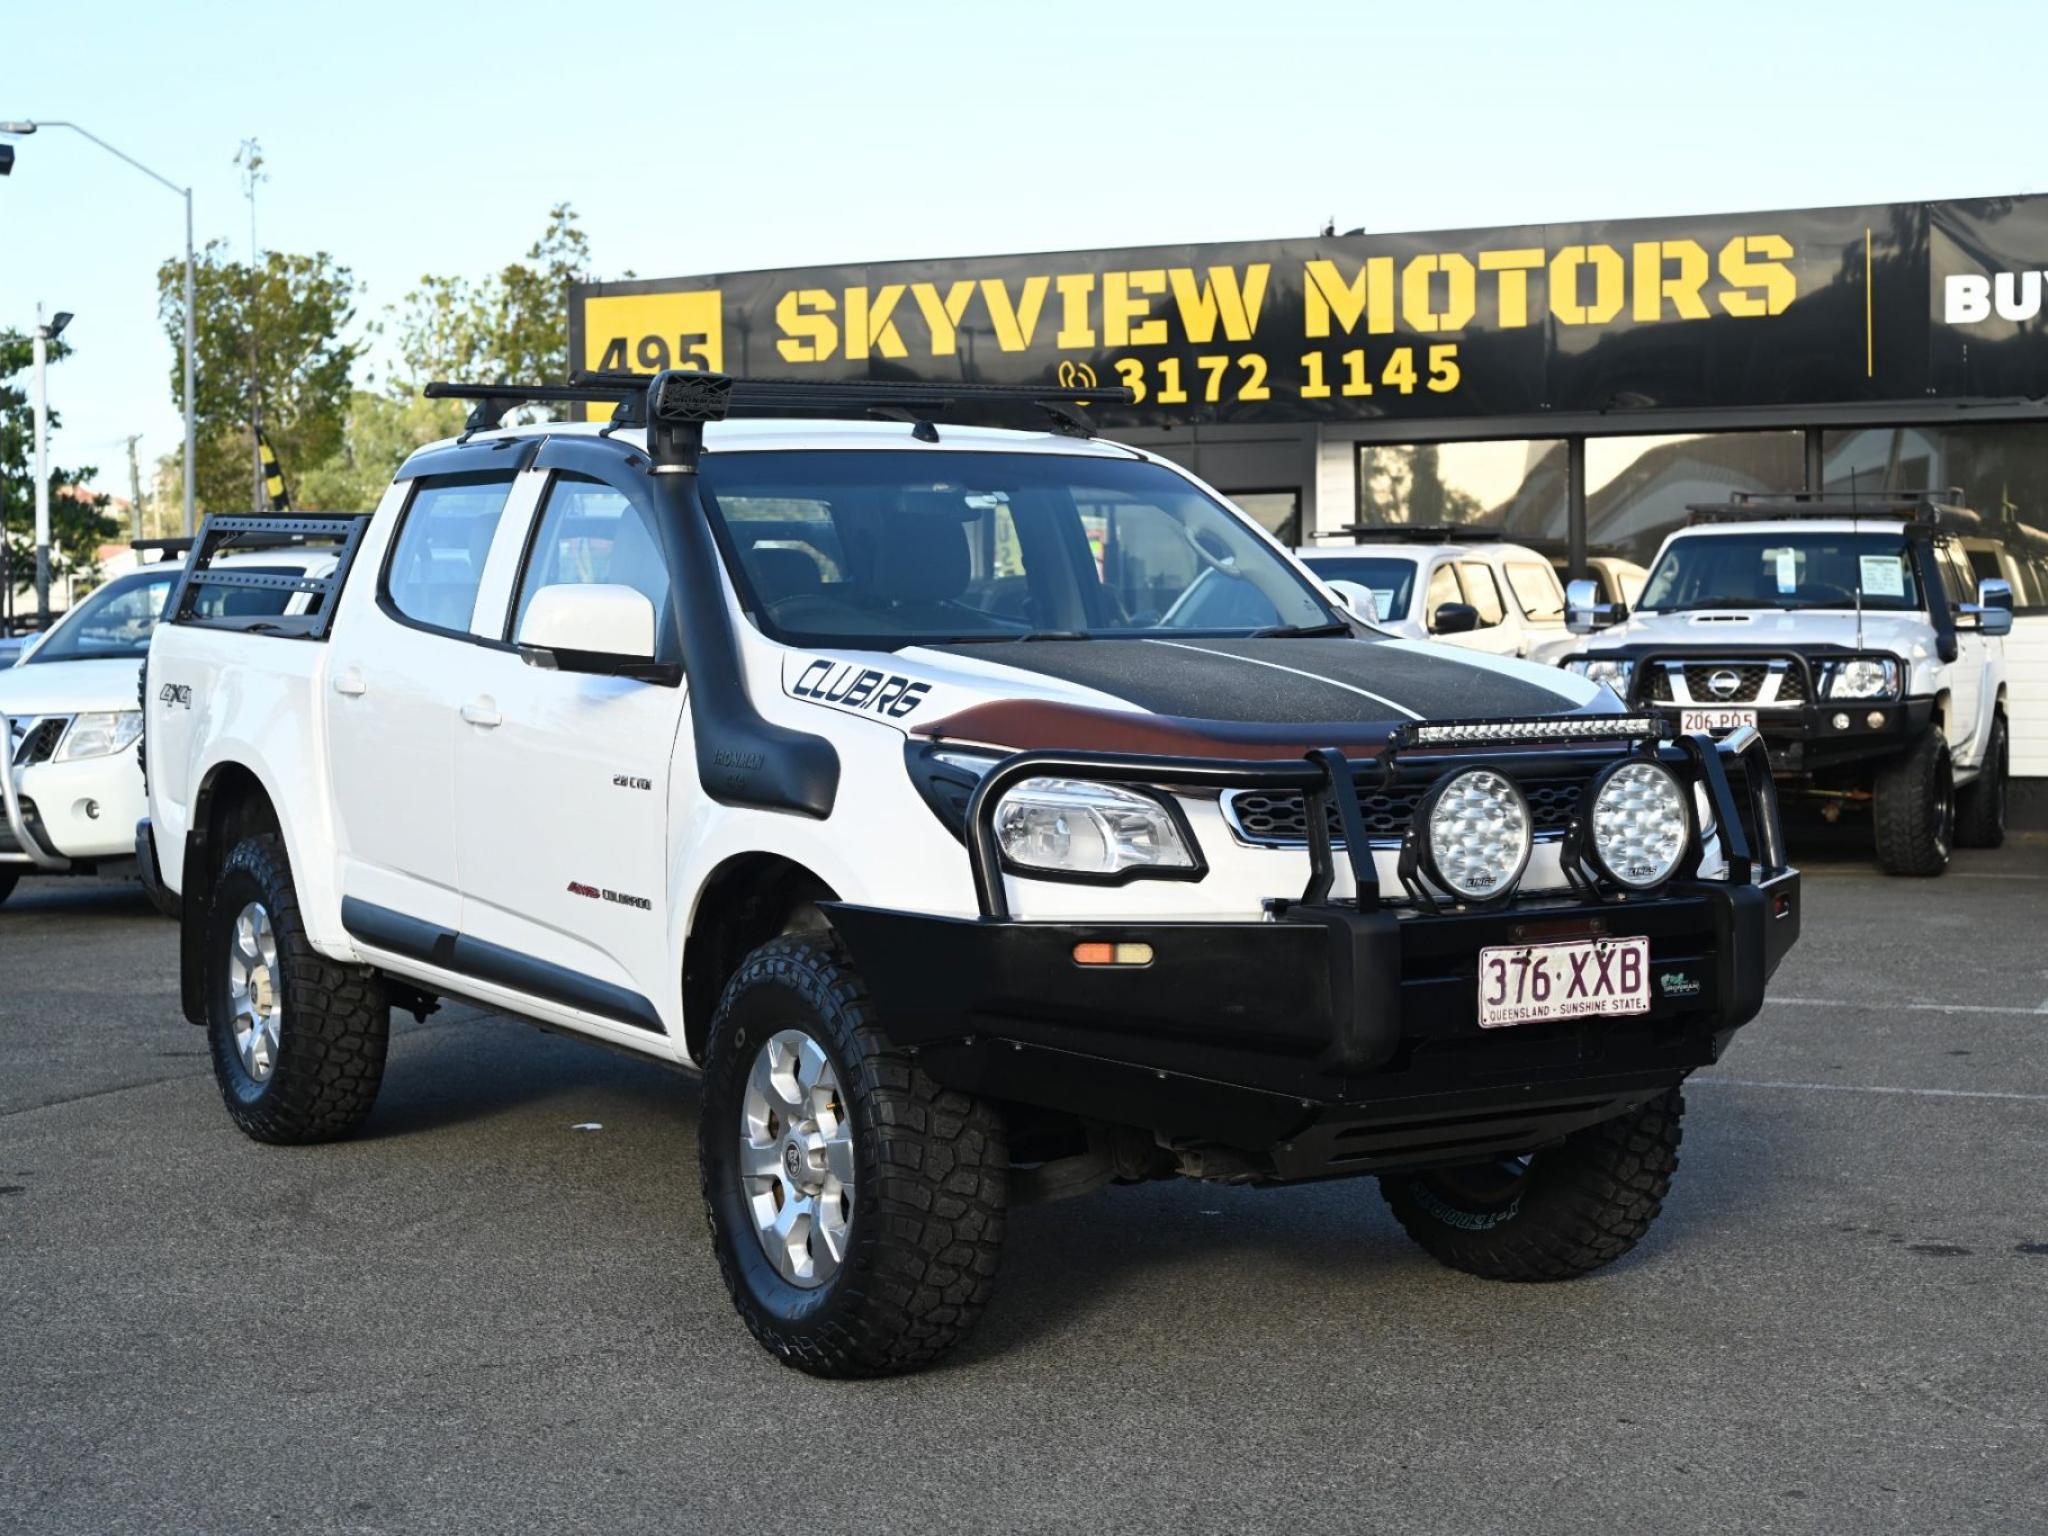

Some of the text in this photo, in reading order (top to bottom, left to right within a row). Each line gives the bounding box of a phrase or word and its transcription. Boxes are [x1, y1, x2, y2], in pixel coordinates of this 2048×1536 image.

[776, 236, 1799, 364] SKYVIEW MOTORS
[1945, 270, 2048, 324] BU
[597, 332, 711, 374] 495
[1114, 343, 1461, 405] 3172 1145
[1489, 998, 1643, 1021] QUEENSLAND SUNSHINE STATE
